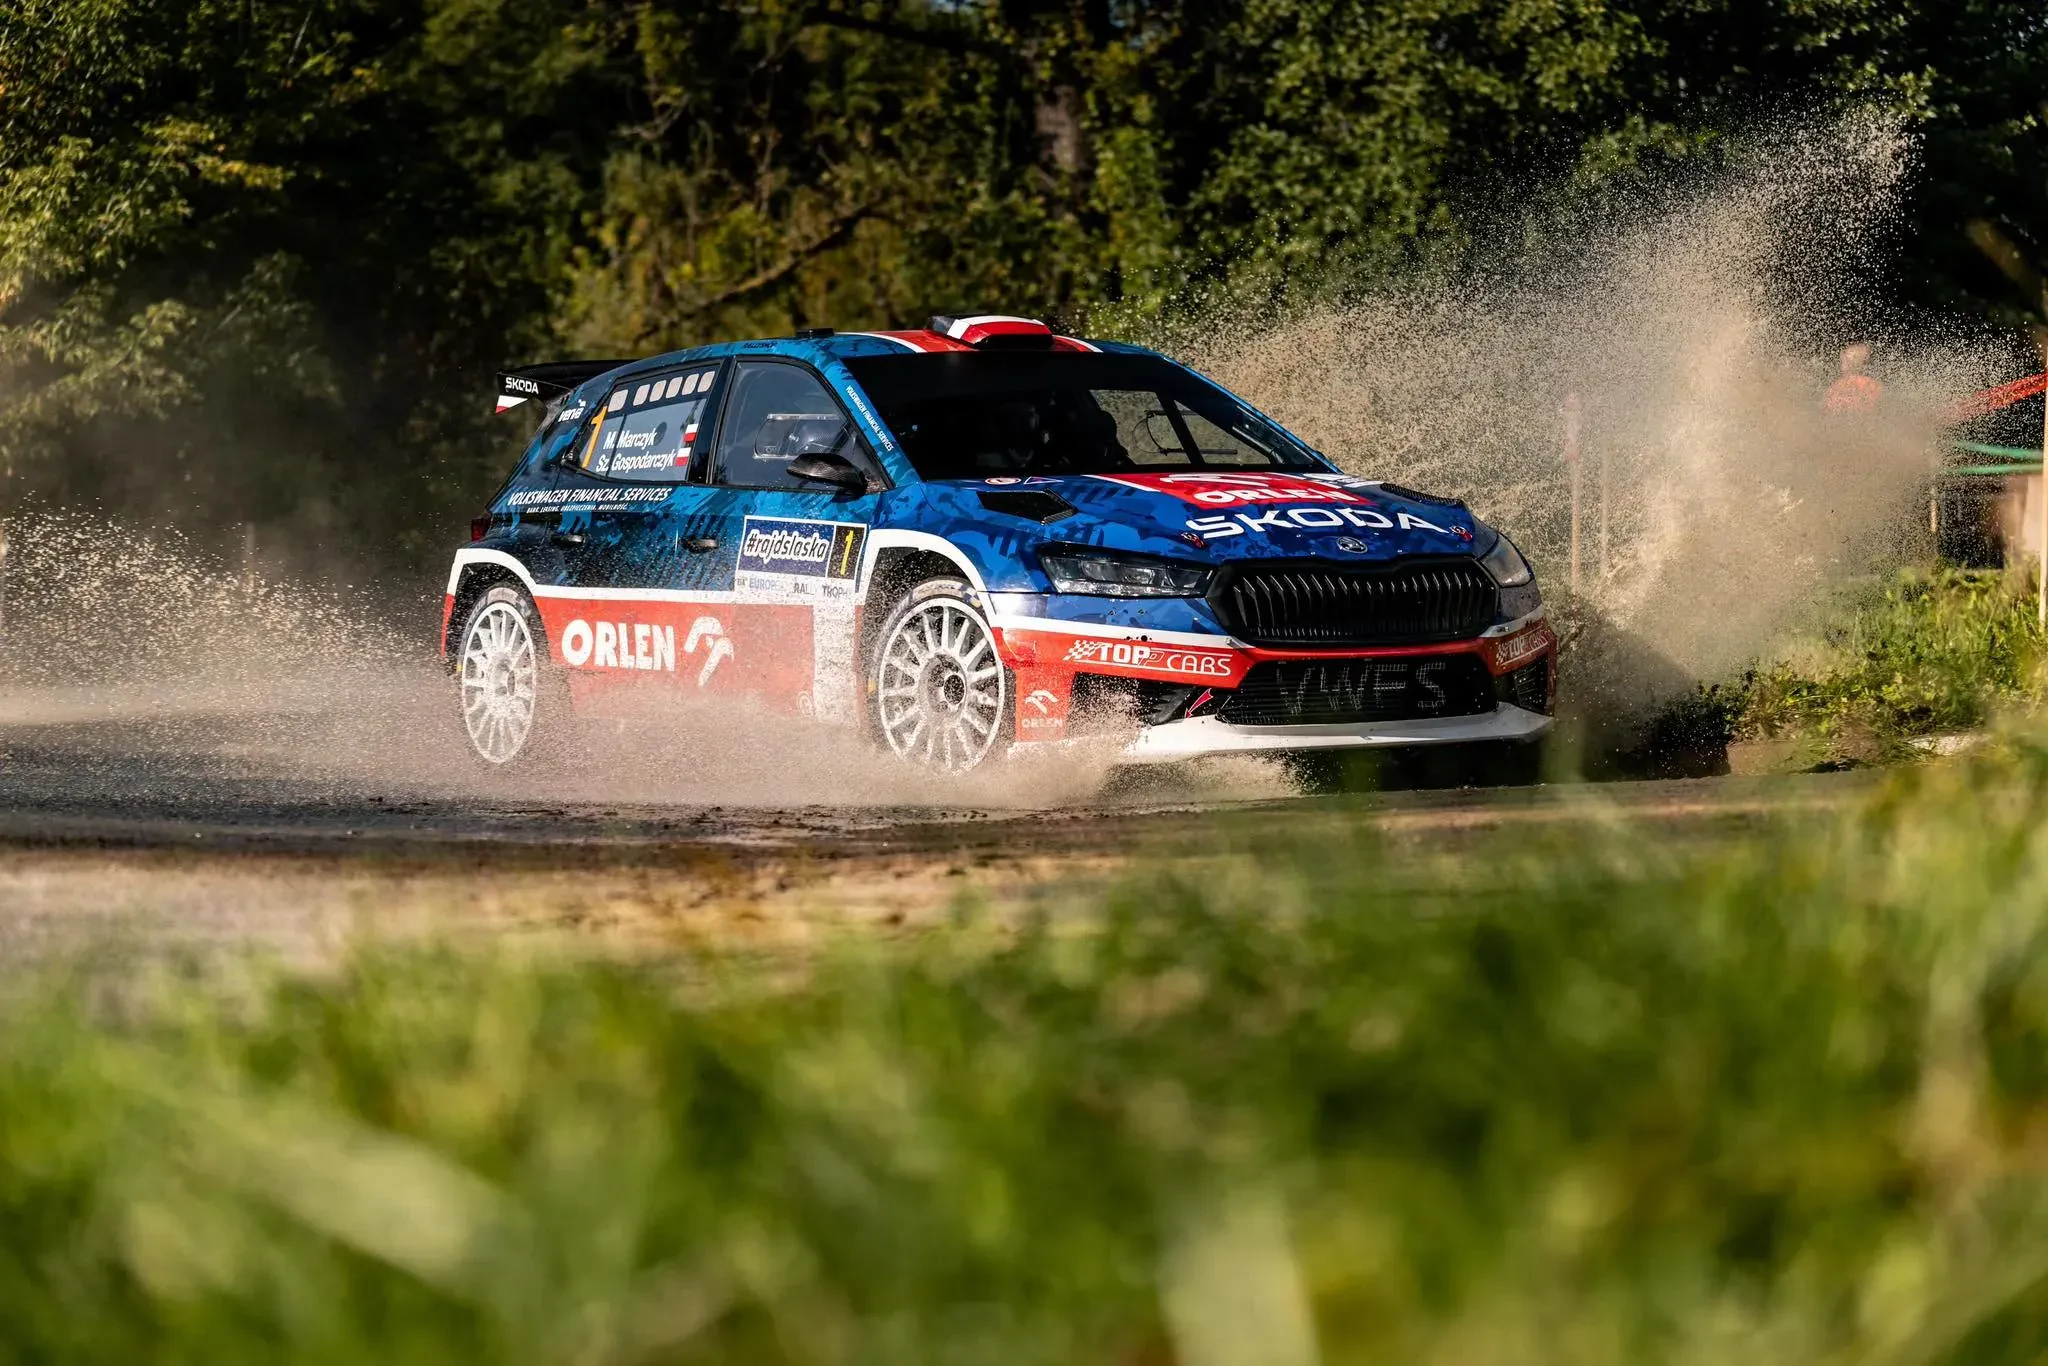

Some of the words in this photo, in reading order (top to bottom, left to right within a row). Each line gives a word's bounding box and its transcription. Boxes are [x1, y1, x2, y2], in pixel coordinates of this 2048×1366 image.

[557, 407, 585, 423] verva
[846, 385, 867, 413] VOLKSWAGEN
[862, 410, 881, 434] FINANCIAL
[877, 430, 894, 452] SERVICES
[582, 405, 609, 468] 1
[603, 430, 617, 450] M.
[617, 427, 658, 450] Marczyk
[611, 449, 677, 474] Gospodarczyk
[507, 489, 570, 506] VOLKSWAGEN
[569, 488, 623, 503] FINANCIAL
[620, 487, 673, 502] SERVICES
[1193, 488, 1360, 503] ORLEN
[840, 530, 855, 576] 1
[561, 619, 676, 672] ORLEN
[1166, 654, 1232, 677] CARS
